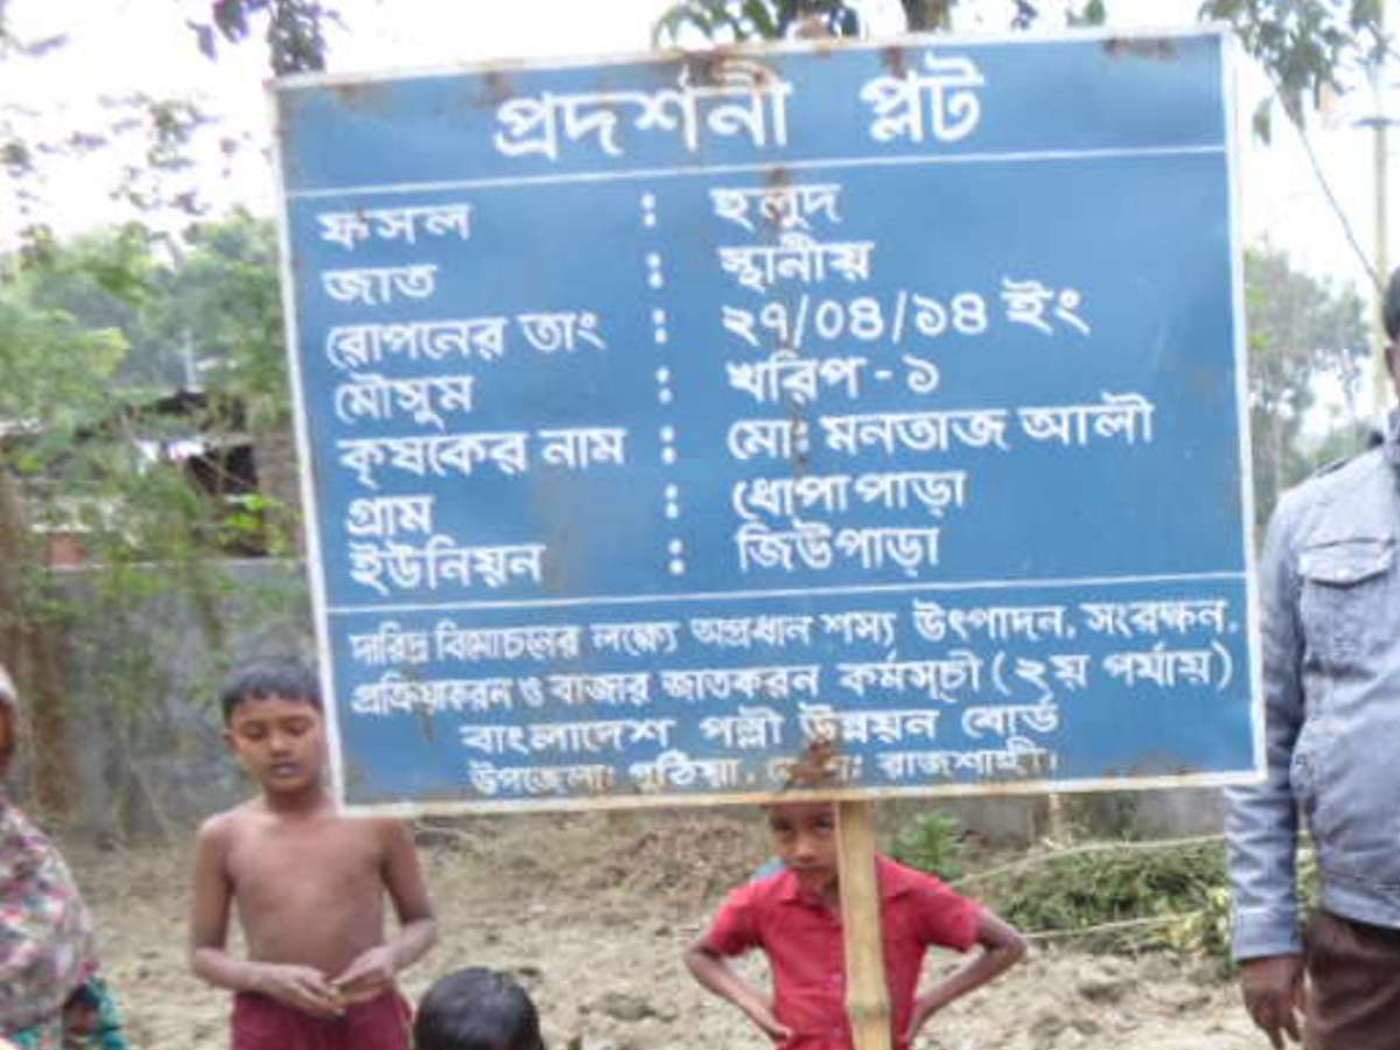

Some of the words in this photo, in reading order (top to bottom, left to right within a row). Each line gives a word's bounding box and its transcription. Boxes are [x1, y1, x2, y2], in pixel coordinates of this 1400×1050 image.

[494, 58, 794, 161] প্রদর্শনী
[860, 52, 985, 143] প্লট
[317, 203, 471, 250] ফসল
[321, 265, 438, 306] জাত
[718, 232, 876, 293] স্থানীয়
[325, 317, 507, 371] রোপনের
[517, 311, 606, 352] তাং
[1002, 275, 1092, 337] ইং
[334, 372, 476, 429] মৌসুম
[726, 349, 868, 402] খরিপ
[902, 355, 940, 393] ১
[337, 432, 532, 490] কৃষকের
[538, 427, 629, 470] নাম
[818, 409, 1008, 456] মনতাজ
[1017, 391, 1156, 446] আলী
[345, 494, 437, 537] গ্রাম
[349, 533, 547, 597] ইউনিয়ন
[736, 519, 941, 578] জিউপাড়া
[459, 719, 676, 755] বাংলাদেশ
[698, 702, 786, 749] পল্লী
[961, 693, 1060, 738] বোর্ড
